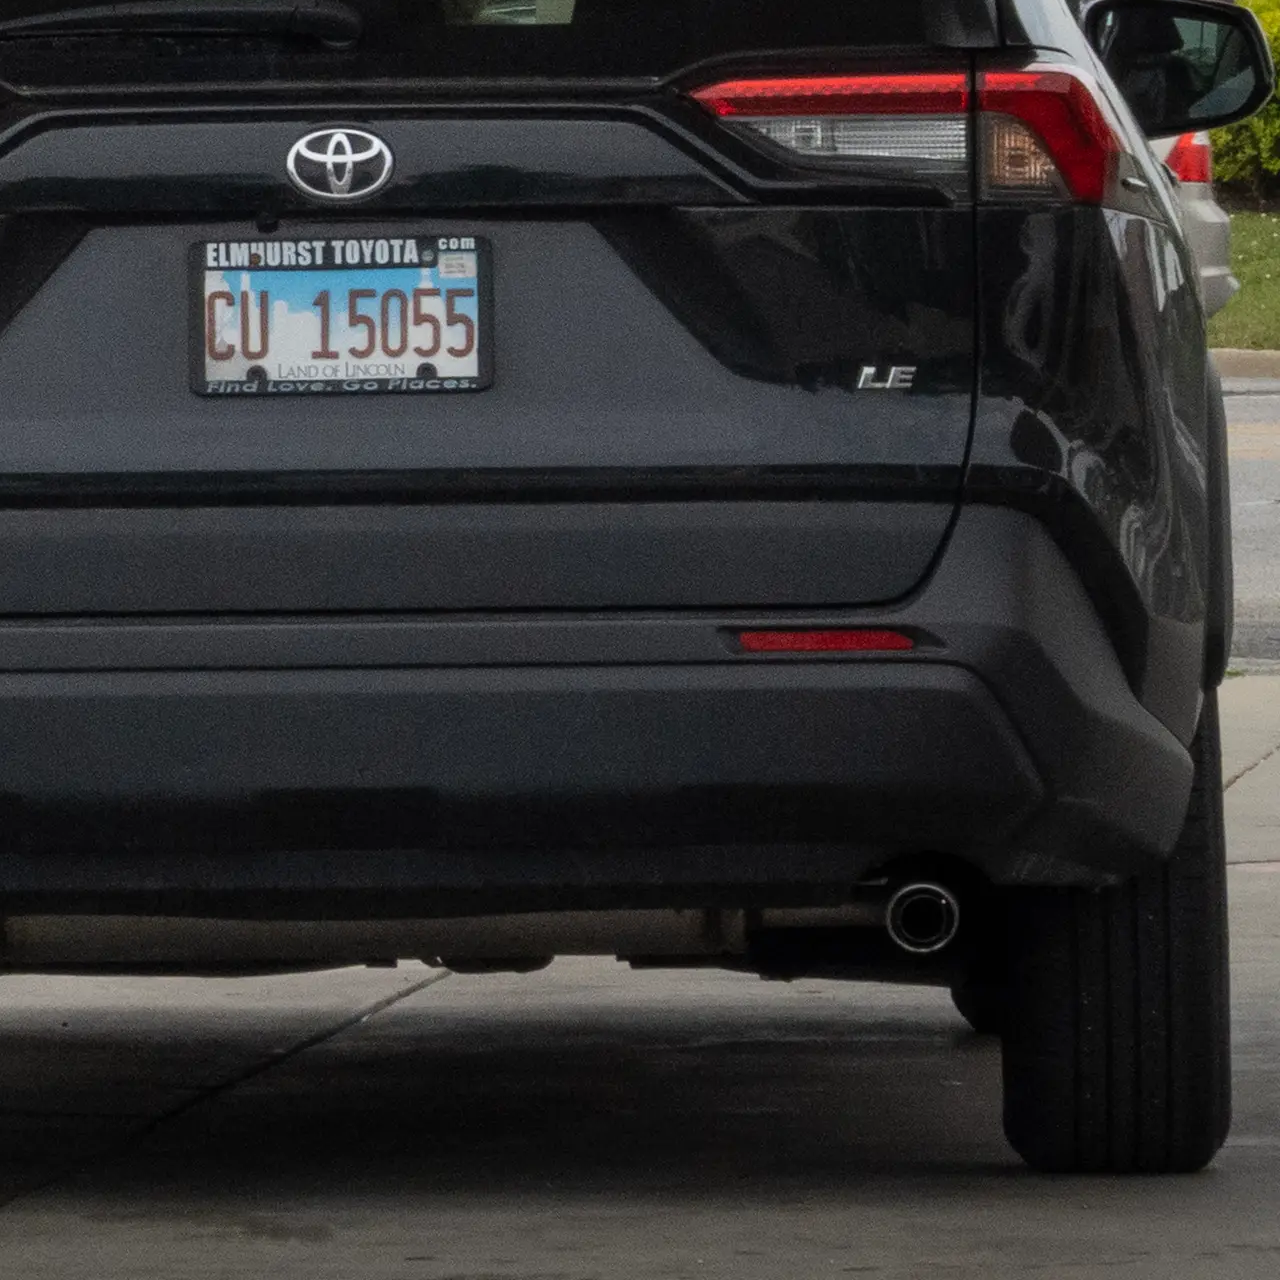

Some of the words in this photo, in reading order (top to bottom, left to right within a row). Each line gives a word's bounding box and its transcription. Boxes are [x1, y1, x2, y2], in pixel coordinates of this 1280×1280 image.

[206, 239, 326, 269] ELMHURST
[331, 238, 420, 267] TOYOTA
[438, 237, 476, 251] com
[207, 290, 269, 360] CU
[310, 287, 475, 361] 15055
[277, 363, 319, 380] LAND
[322, 363, 341, 379] OF
[344, 361, 407, 378] LINCOLN
[856, 365, 917, 391] LE
[207, 380, 259, 394] Find
[341, 379, 380, 393] Go
